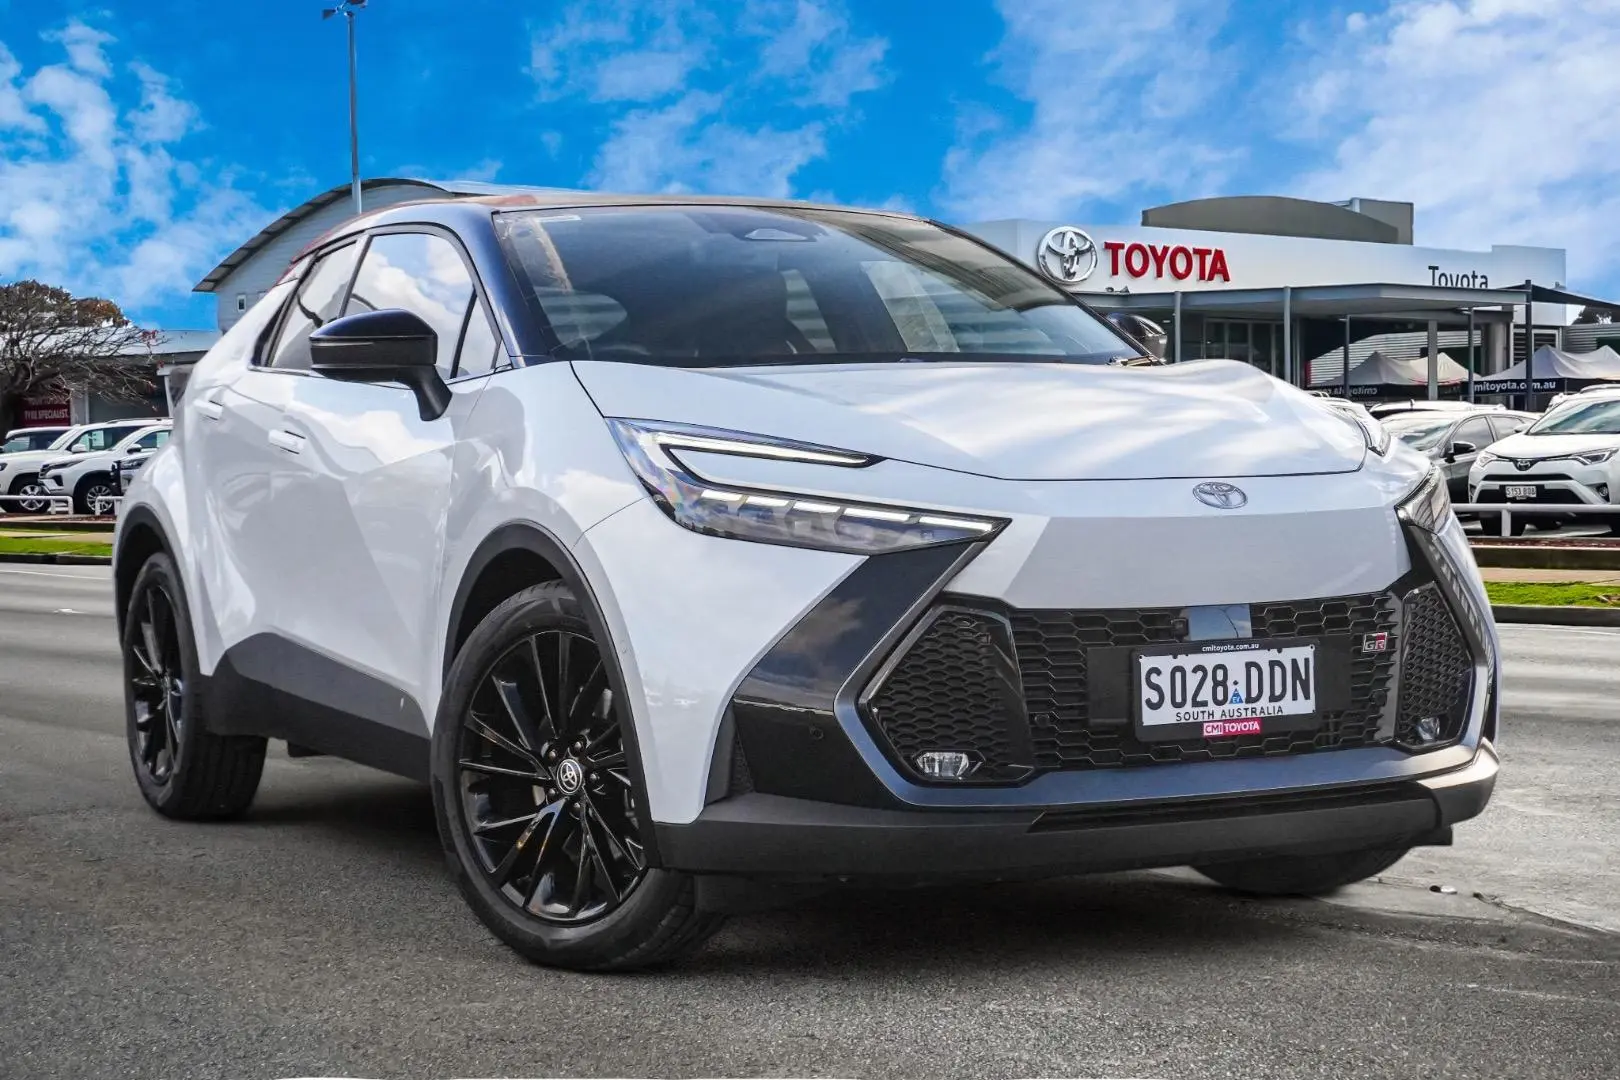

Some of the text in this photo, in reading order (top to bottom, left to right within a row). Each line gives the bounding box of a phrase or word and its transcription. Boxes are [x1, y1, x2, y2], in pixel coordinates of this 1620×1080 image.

[1104, 242, 1231, 282] TOYOTA
[1428, 265, 1488, 288] Toyota
[1474, 381, 1556, 392] mitoyota.cm.au
[1202, 643, 1260, 653] cmitoyota.com.au
[1365, 640, 1385, 650] GR
[1175, 705, 1284, 722] SOUTH AUSTRALIA
[1223, 721, 1260, 733] TOYOTA
